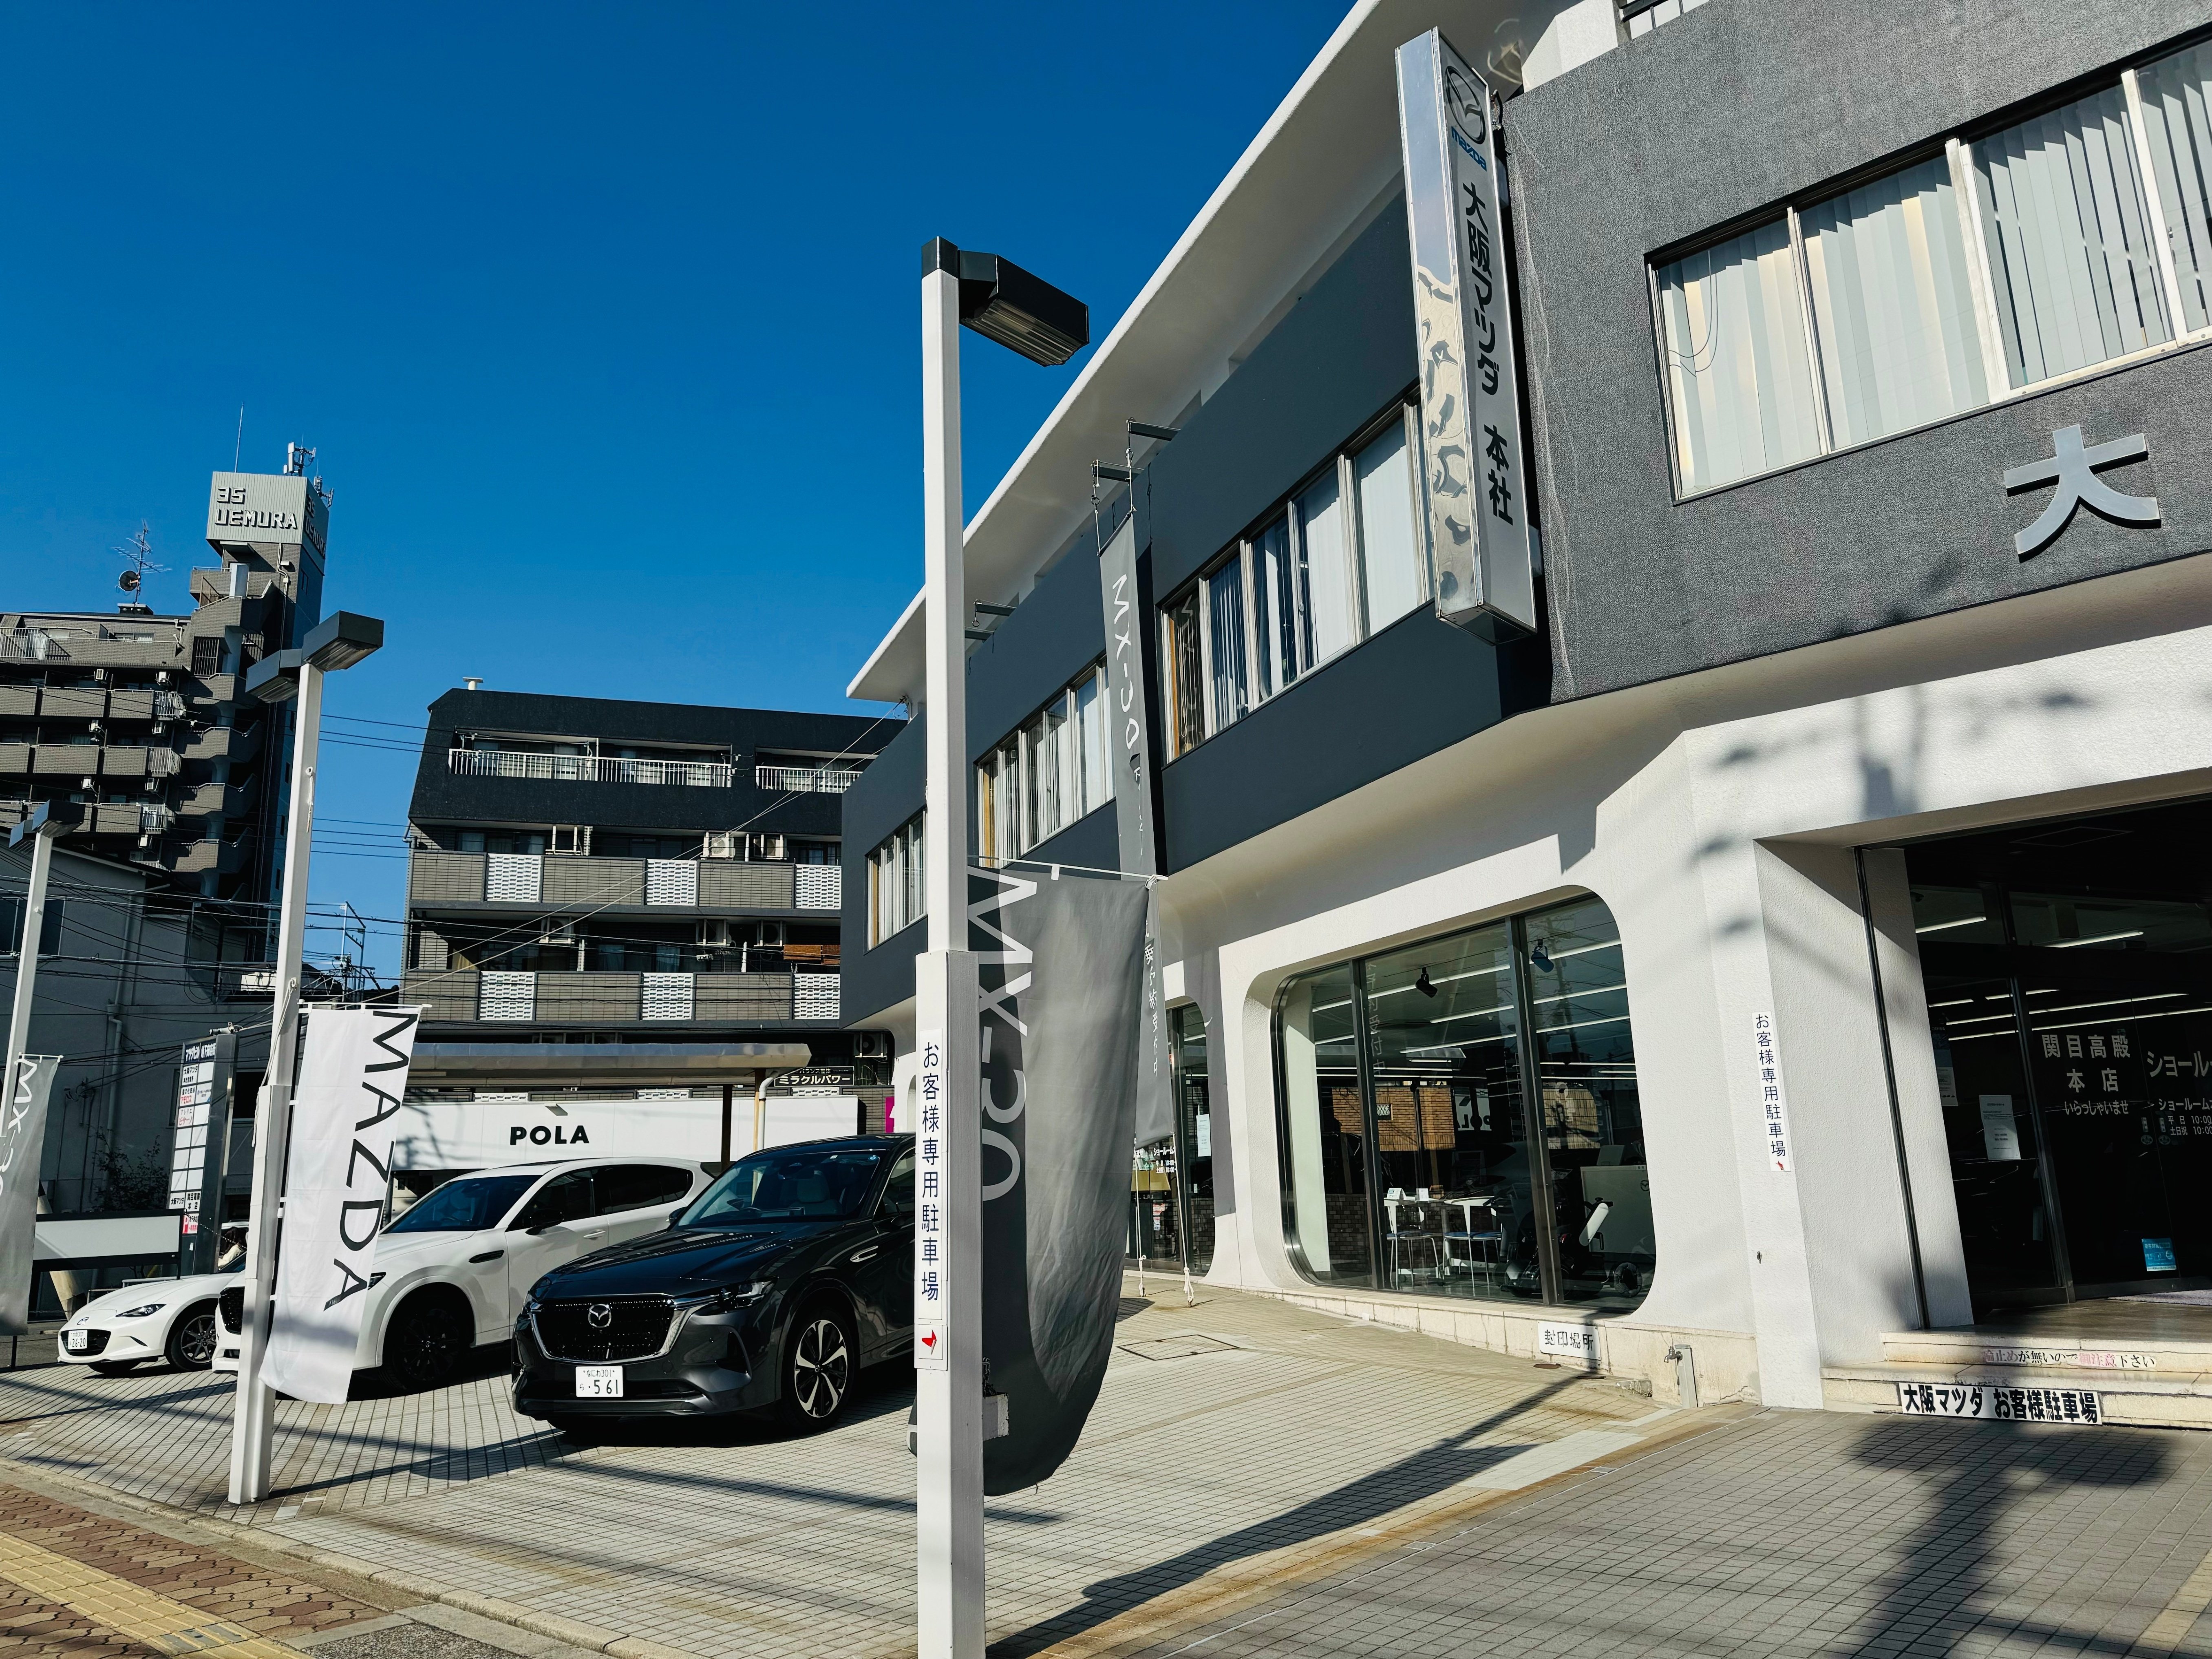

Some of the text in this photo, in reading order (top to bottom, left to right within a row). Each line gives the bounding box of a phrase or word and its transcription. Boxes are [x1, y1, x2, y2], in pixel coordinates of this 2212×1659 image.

[1462, 181, 1514, 526] 大阪マツダ 本社
[216, 486, 245, 504] 35
[2003, 423, 2161, 558] 大
[214, 508, 298, 530] UEMURA
[2042, 1034, 2131, 1059] 関目高殿
[779, 1074, 850, 1085] ミラクルパワー
[1755, 1014, 1786, 1157] お客様専用駐車場
[2064, 1100, 2129, 1116] いらっしゃいませ
[0, 1058, 38, 1197] MX-3
[509, 1124, 589, 1146] POLA
[2170, 1126, 2188, 1136] 土日祝
[323, 1010, 419, 1312] MAZDA
[921, 1041, 940, 1301] お客様専用駐車場
[1544, 1329, 1594, 1351] 封印場所
[587, 1369, 612, 1377] なにわ301
[1903, 1384, 2098, 1423] 大阪マツダ お客様駐車場
